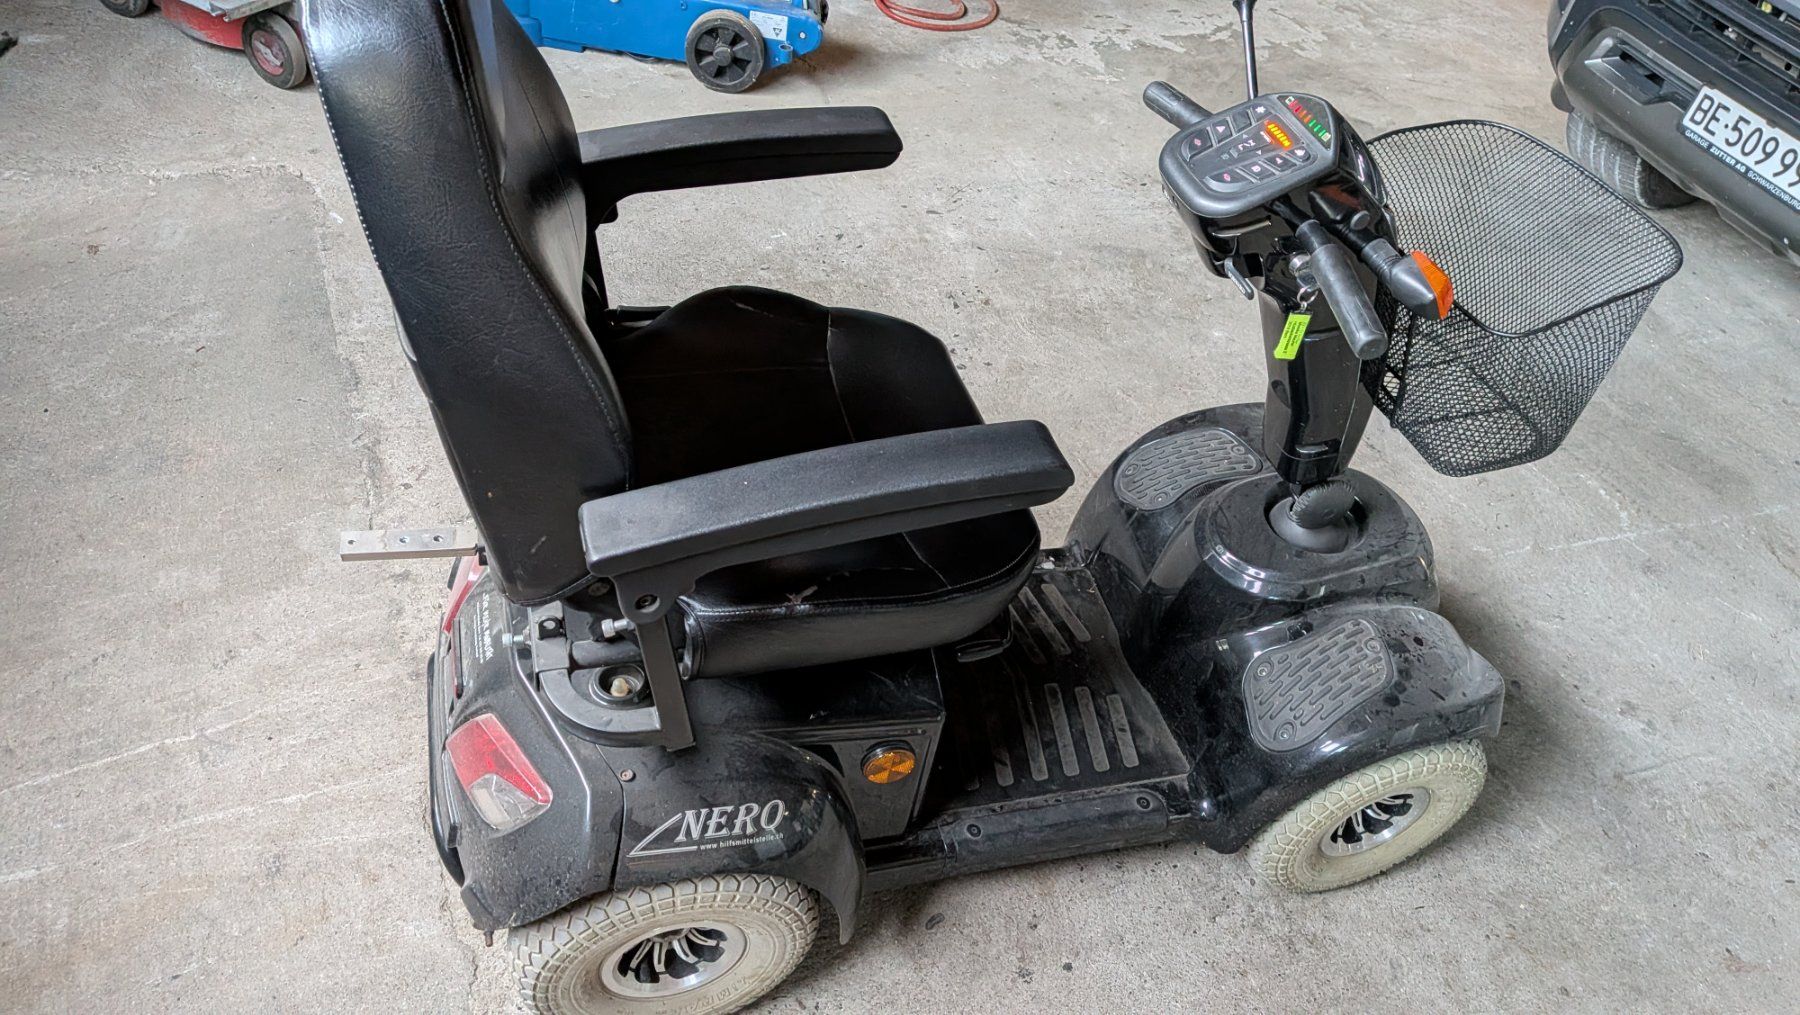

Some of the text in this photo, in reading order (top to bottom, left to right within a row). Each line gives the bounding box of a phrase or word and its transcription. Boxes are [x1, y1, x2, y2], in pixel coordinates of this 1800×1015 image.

[1684, 129, 1709, 149] GARAGE
[1710, 145, 1737, 166] ZUTTER
[1735, 161, 1747, 174] AG
[674, 799, 785, 843] NERO
